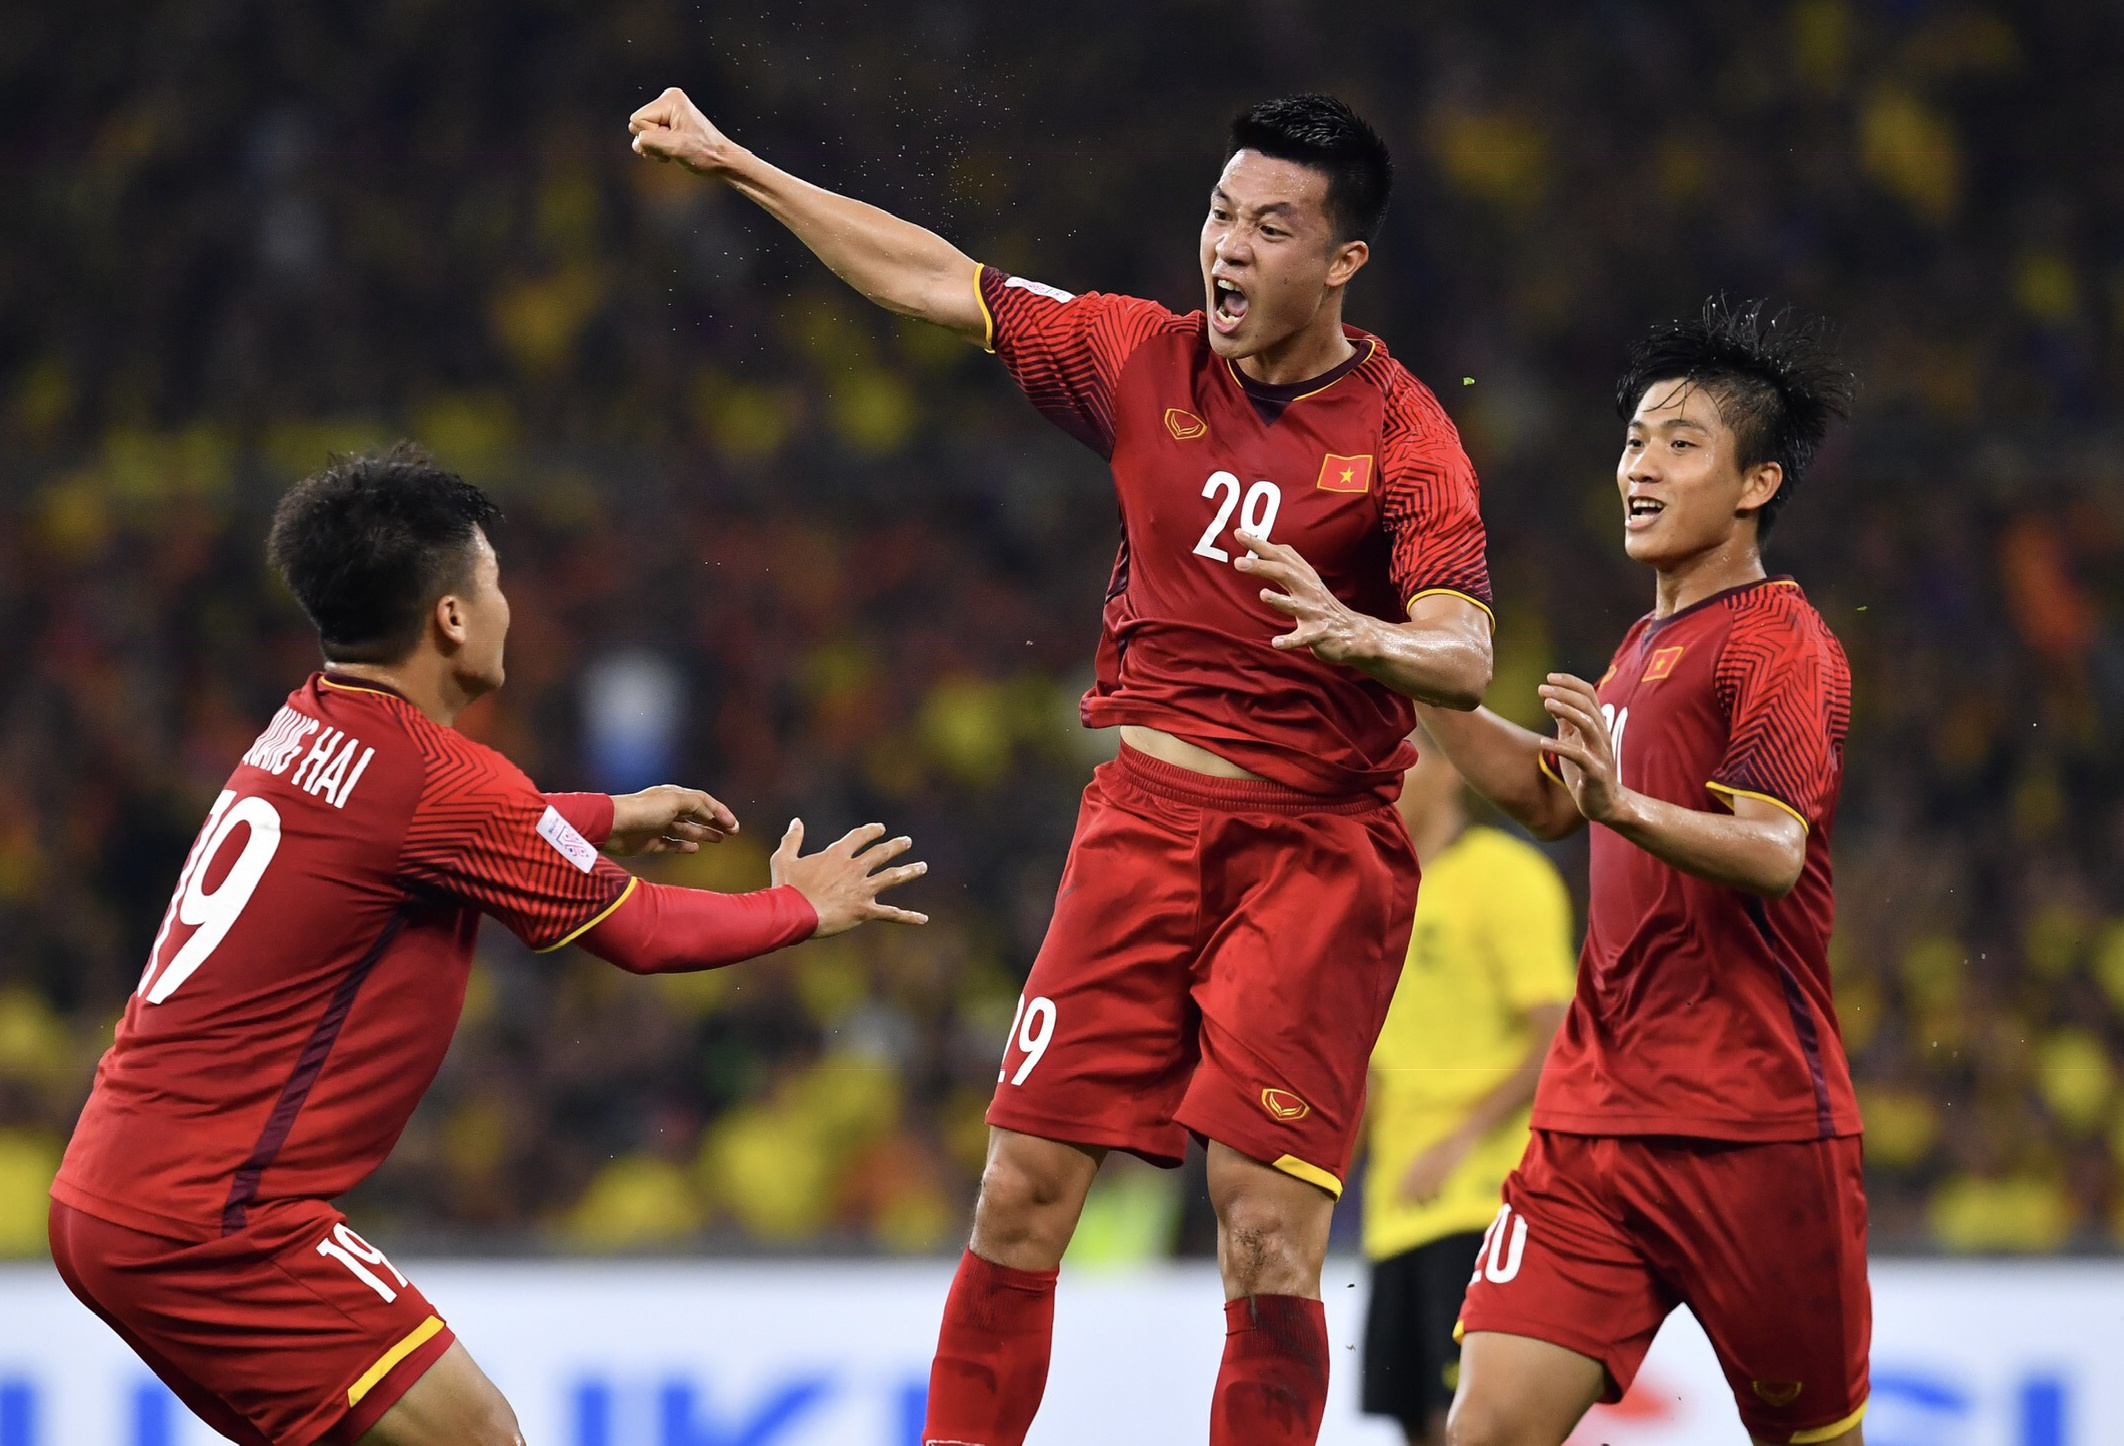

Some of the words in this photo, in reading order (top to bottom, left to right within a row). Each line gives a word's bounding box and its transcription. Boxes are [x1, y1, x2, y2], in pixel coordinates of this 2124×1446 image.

[1192, 470, 1282, 561] 29
[291, 726, 376, 810] HAI
[137, 789, 281, 1005] 19
[316, 1222, 409, 1304] 19
